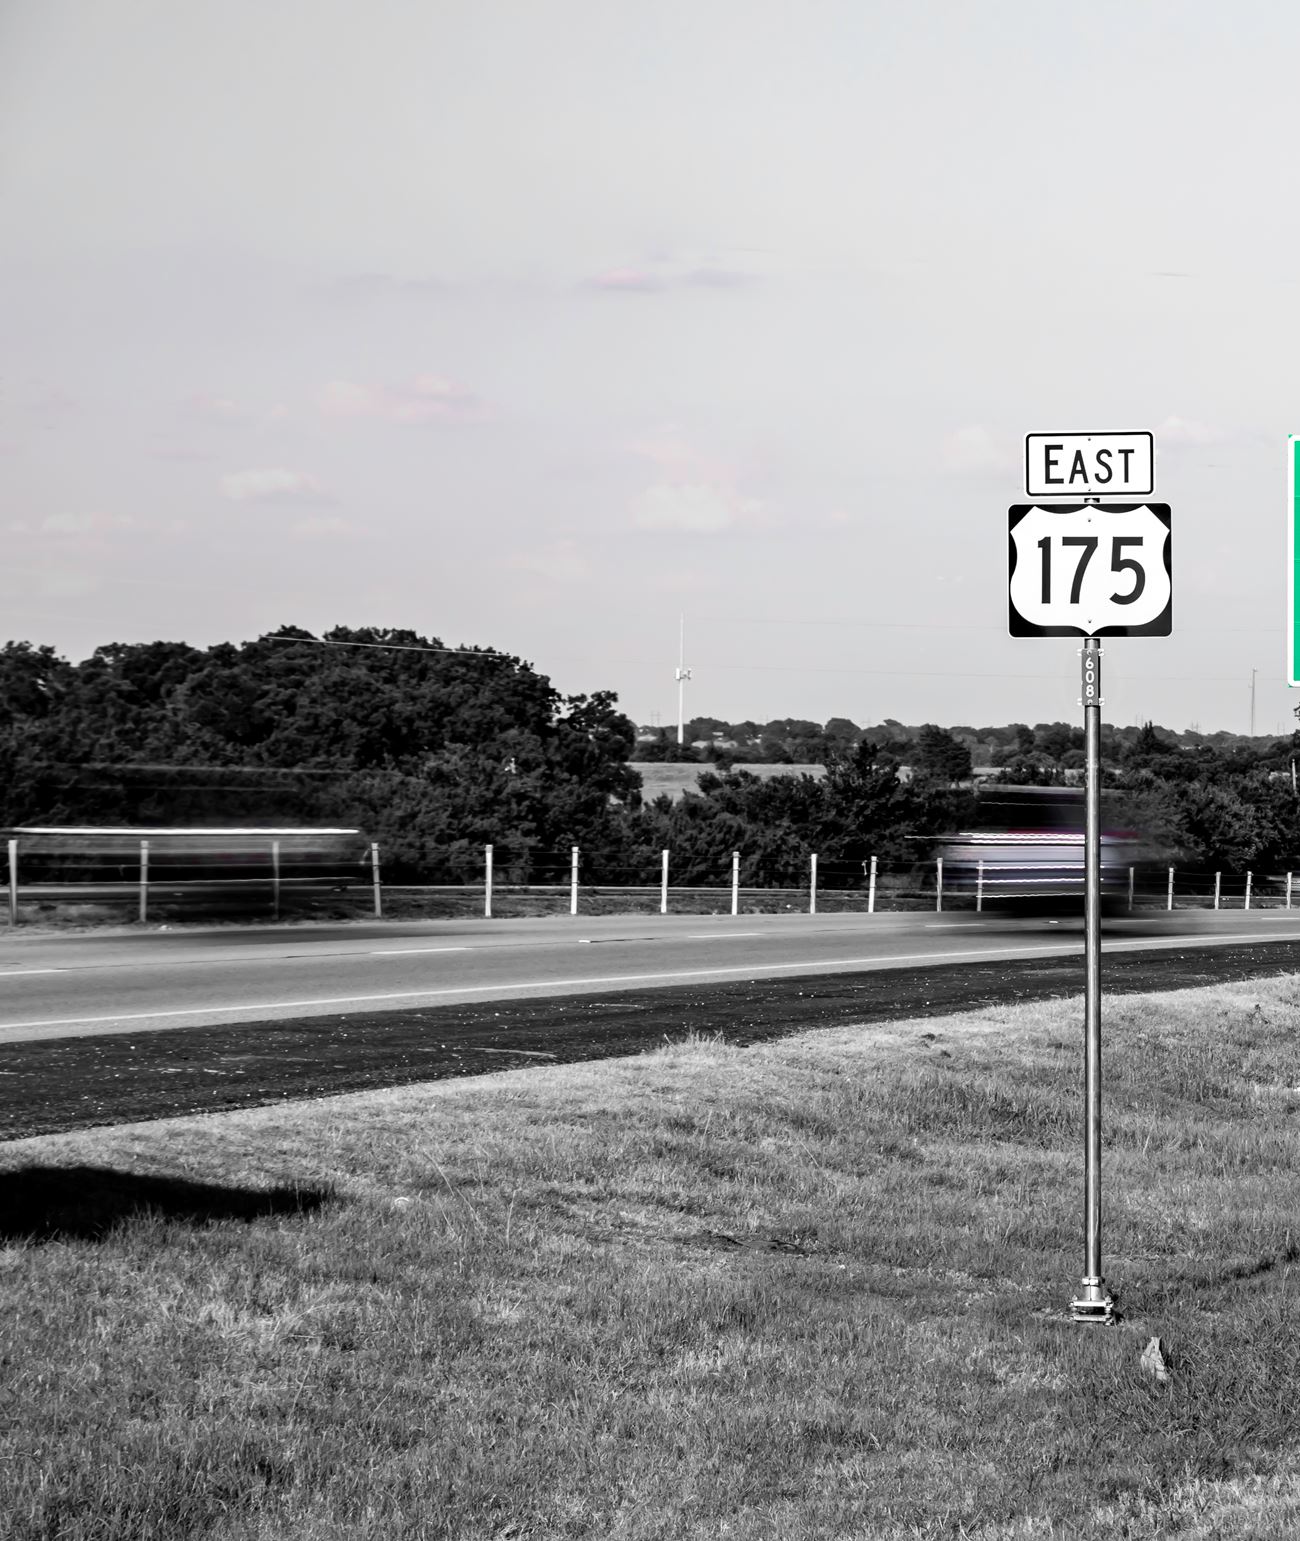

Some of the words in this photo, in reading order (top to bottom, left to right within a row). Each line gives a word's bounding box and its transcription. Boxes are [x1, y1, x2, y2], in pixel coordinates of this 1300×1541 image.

[1044, 444, 1135, 485] EAST
[1037, 536, 1146, 606] 175
[1085, 656, 1095, 698] 608
